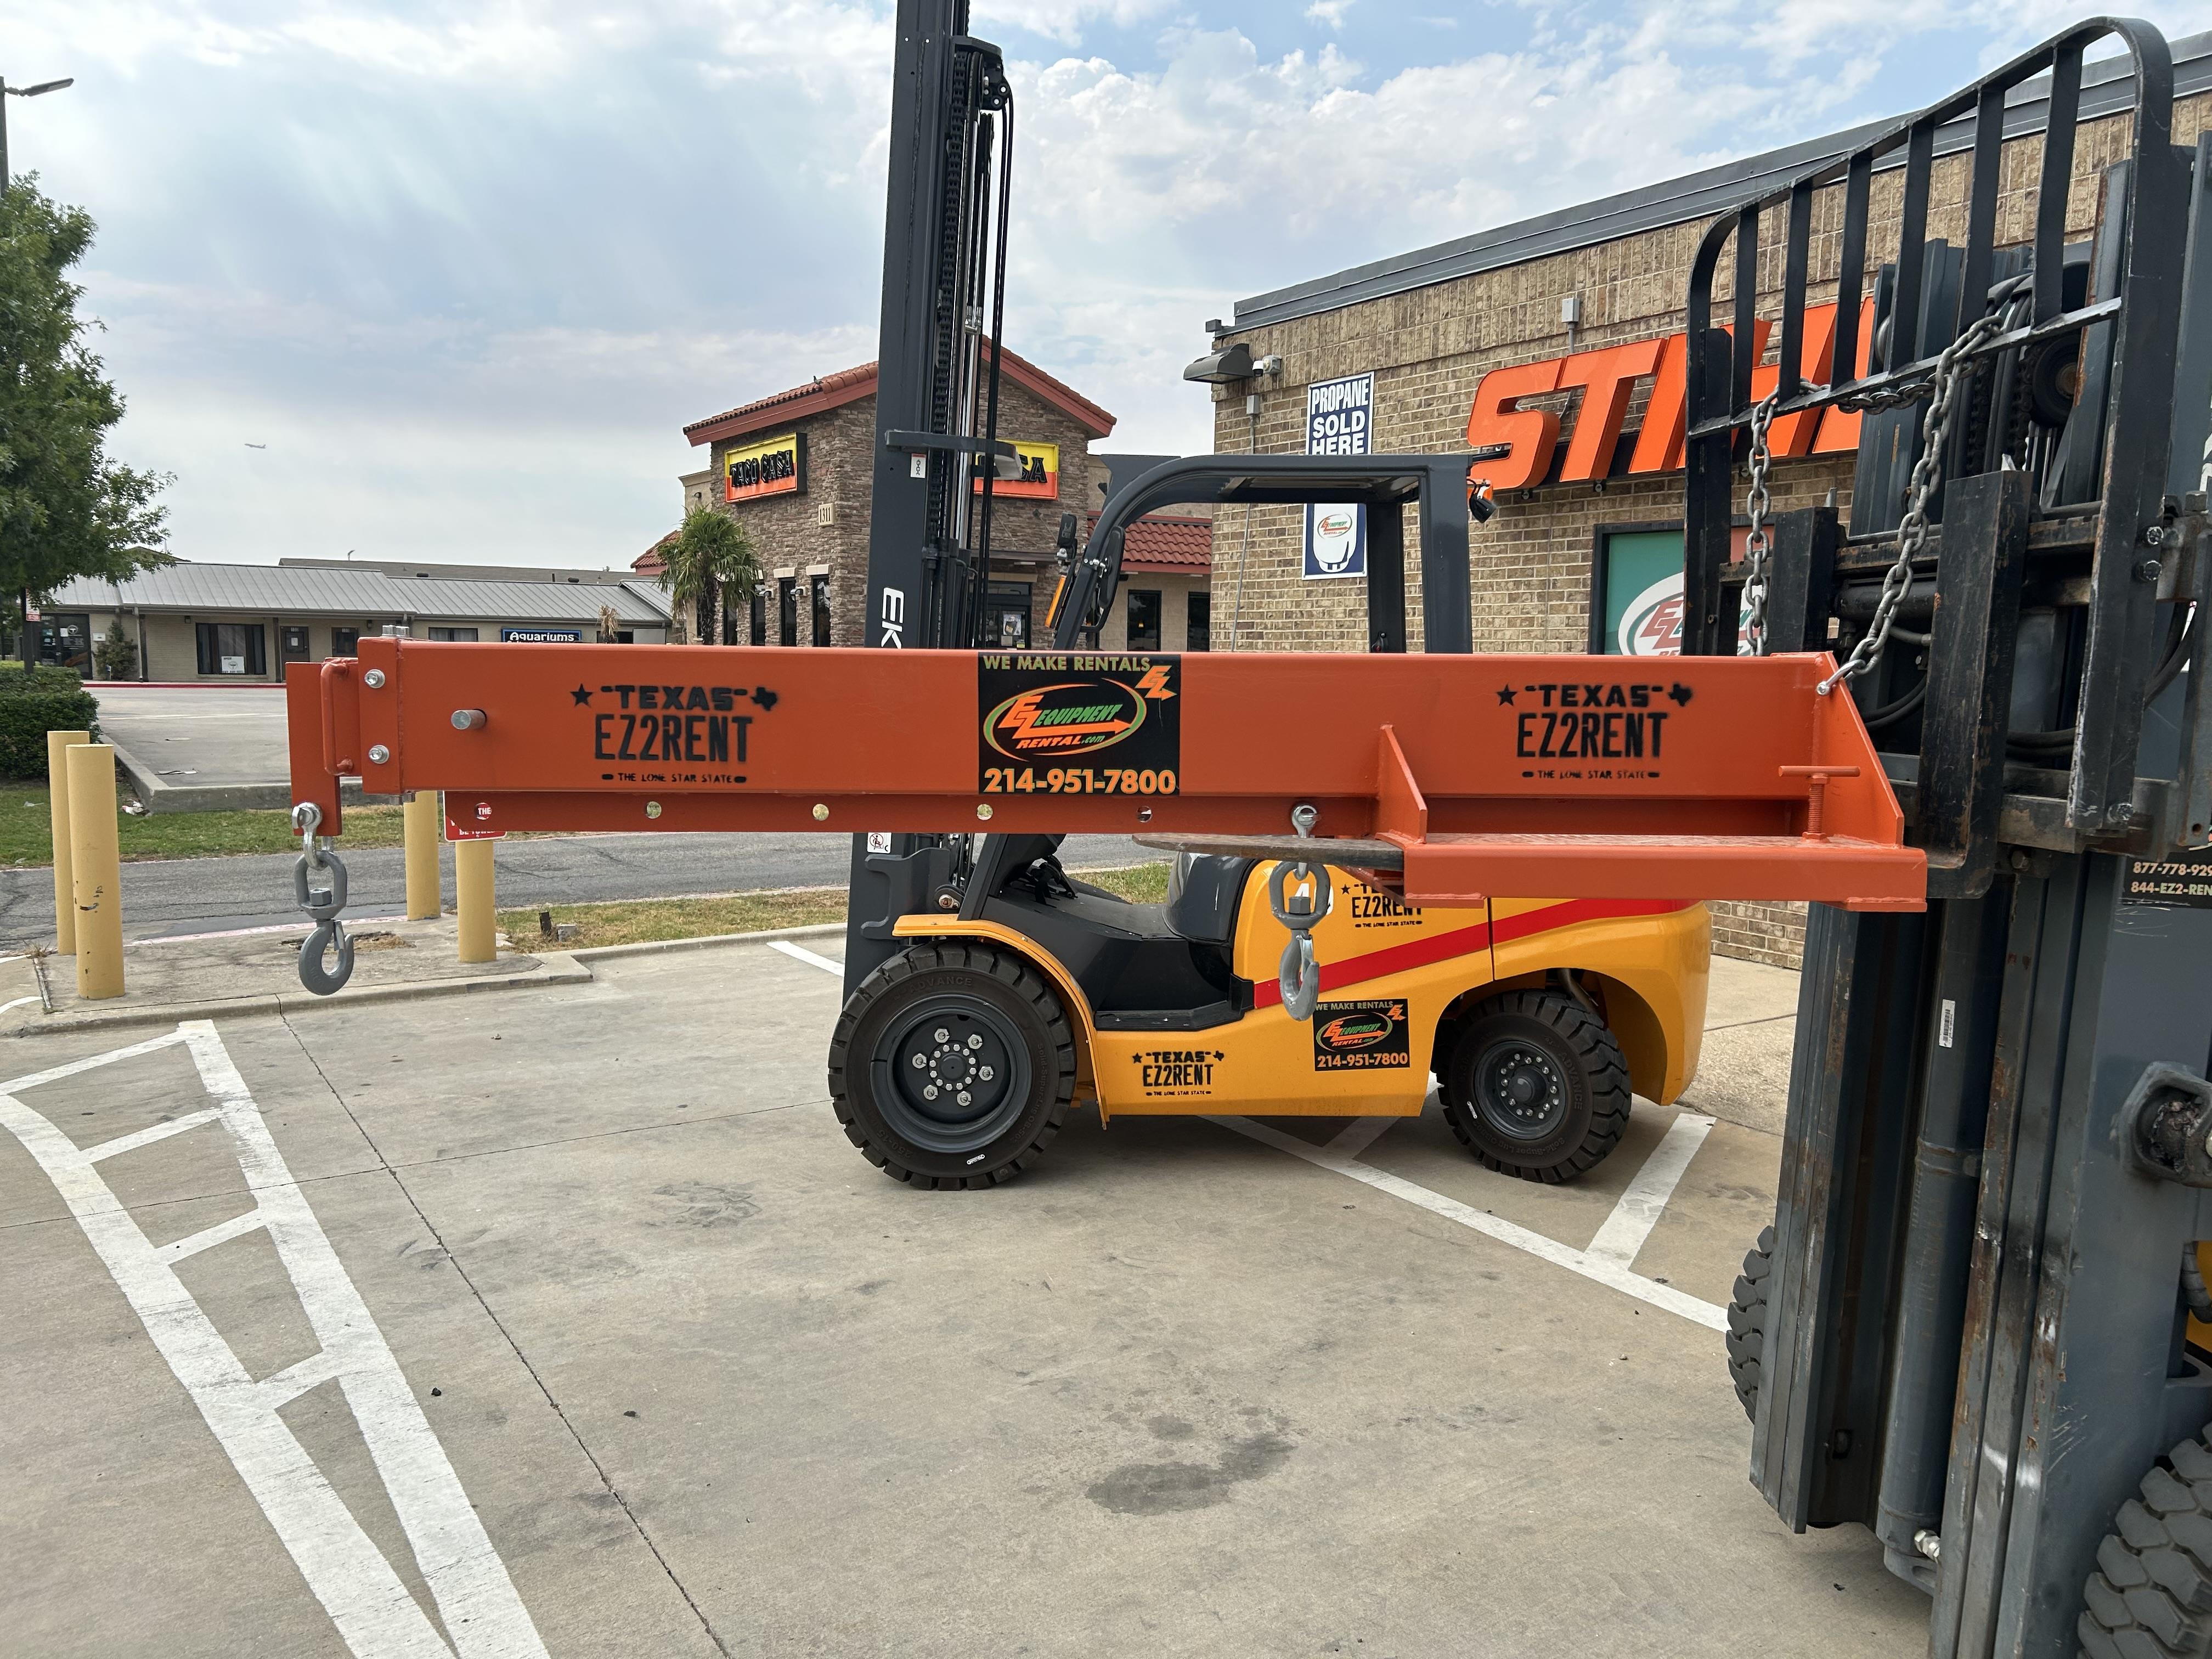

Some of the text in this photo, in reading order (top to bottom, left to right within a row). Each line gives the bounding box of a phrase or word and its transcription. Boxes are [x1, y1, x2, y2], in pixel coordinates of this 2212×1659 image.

[1311, 379, 1369, 415] PROPANE
[1313, 410, 1365, 438] SOLD
[1312, 432, 1364, 455] HERE
[730, 450, 794, 487] TACO CASA
[820, 507, 831, 523] 1311
[510, 632, 574, 641] Aquariums
[983, 656, 1150, 672] WE MAKE RENTALS
[1135, 665, 1177, 701] EZ
[614, 685, 734, 711] TEXAS
[1539, 685, 1649, 707] TEXAS
[1034, 704, 1123, 726] EQUIPMENT
[595, 714, 752, 762] EZ2RENT
[1517, 712, 1668, 758] EZ2RENT
[618, 772, 733, 783] THE LONE STAR STATE
[983, 768, 1176, 794] 214-951-7800
[1538, 770, 1646, 779] THE LONE STAR STATE
[478, 807, 492, 815] THE
[910, 976, 973, 994] ADVANCE
[1316, 1001, 1393, 1012] WE MAKE RENTALS
[1340, 1023, 1381, 1036] EQUIPMENT
[1153, 1051, 1205, 1063] TEXAS
[1317, 1052, 1408, 1068] 214-951-7800
[1143, 1064, 1213, 1087] EZ2RENT
[1561, 1053, 1583, 1110] ADVANCE
